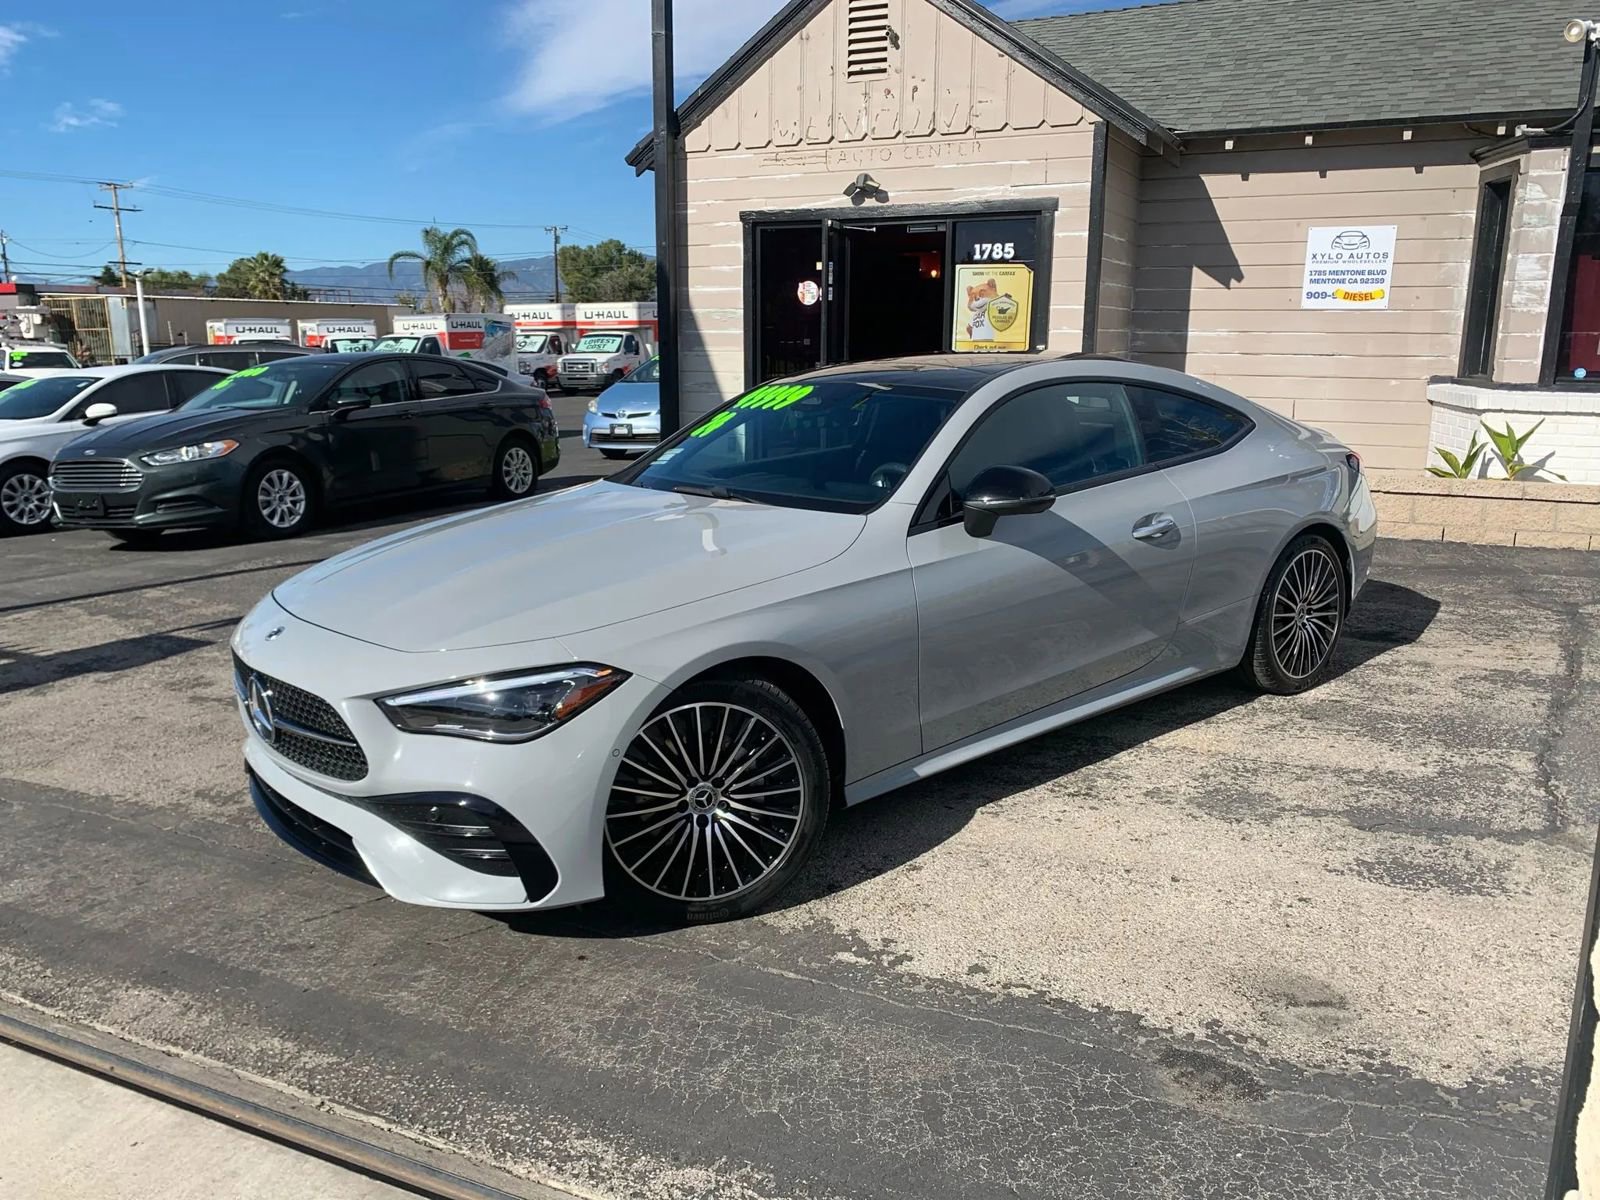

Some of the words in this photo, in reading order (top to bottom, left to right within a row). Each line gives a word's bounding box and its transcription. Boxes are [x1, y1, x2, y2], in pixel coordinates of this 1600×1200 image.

[973, 242, 1015, 260] 1785
[1311, 252, 1344, 260] XYLO
[1348, 252, 1389, 260] AUTOS
[1343, 291, 1375, 302] DIESEL
[584, 310, 629, 319] U-HAUL
[402, 322, 438, 330] U-HAUL
[451, 320, 482, 329] U-HAUL
